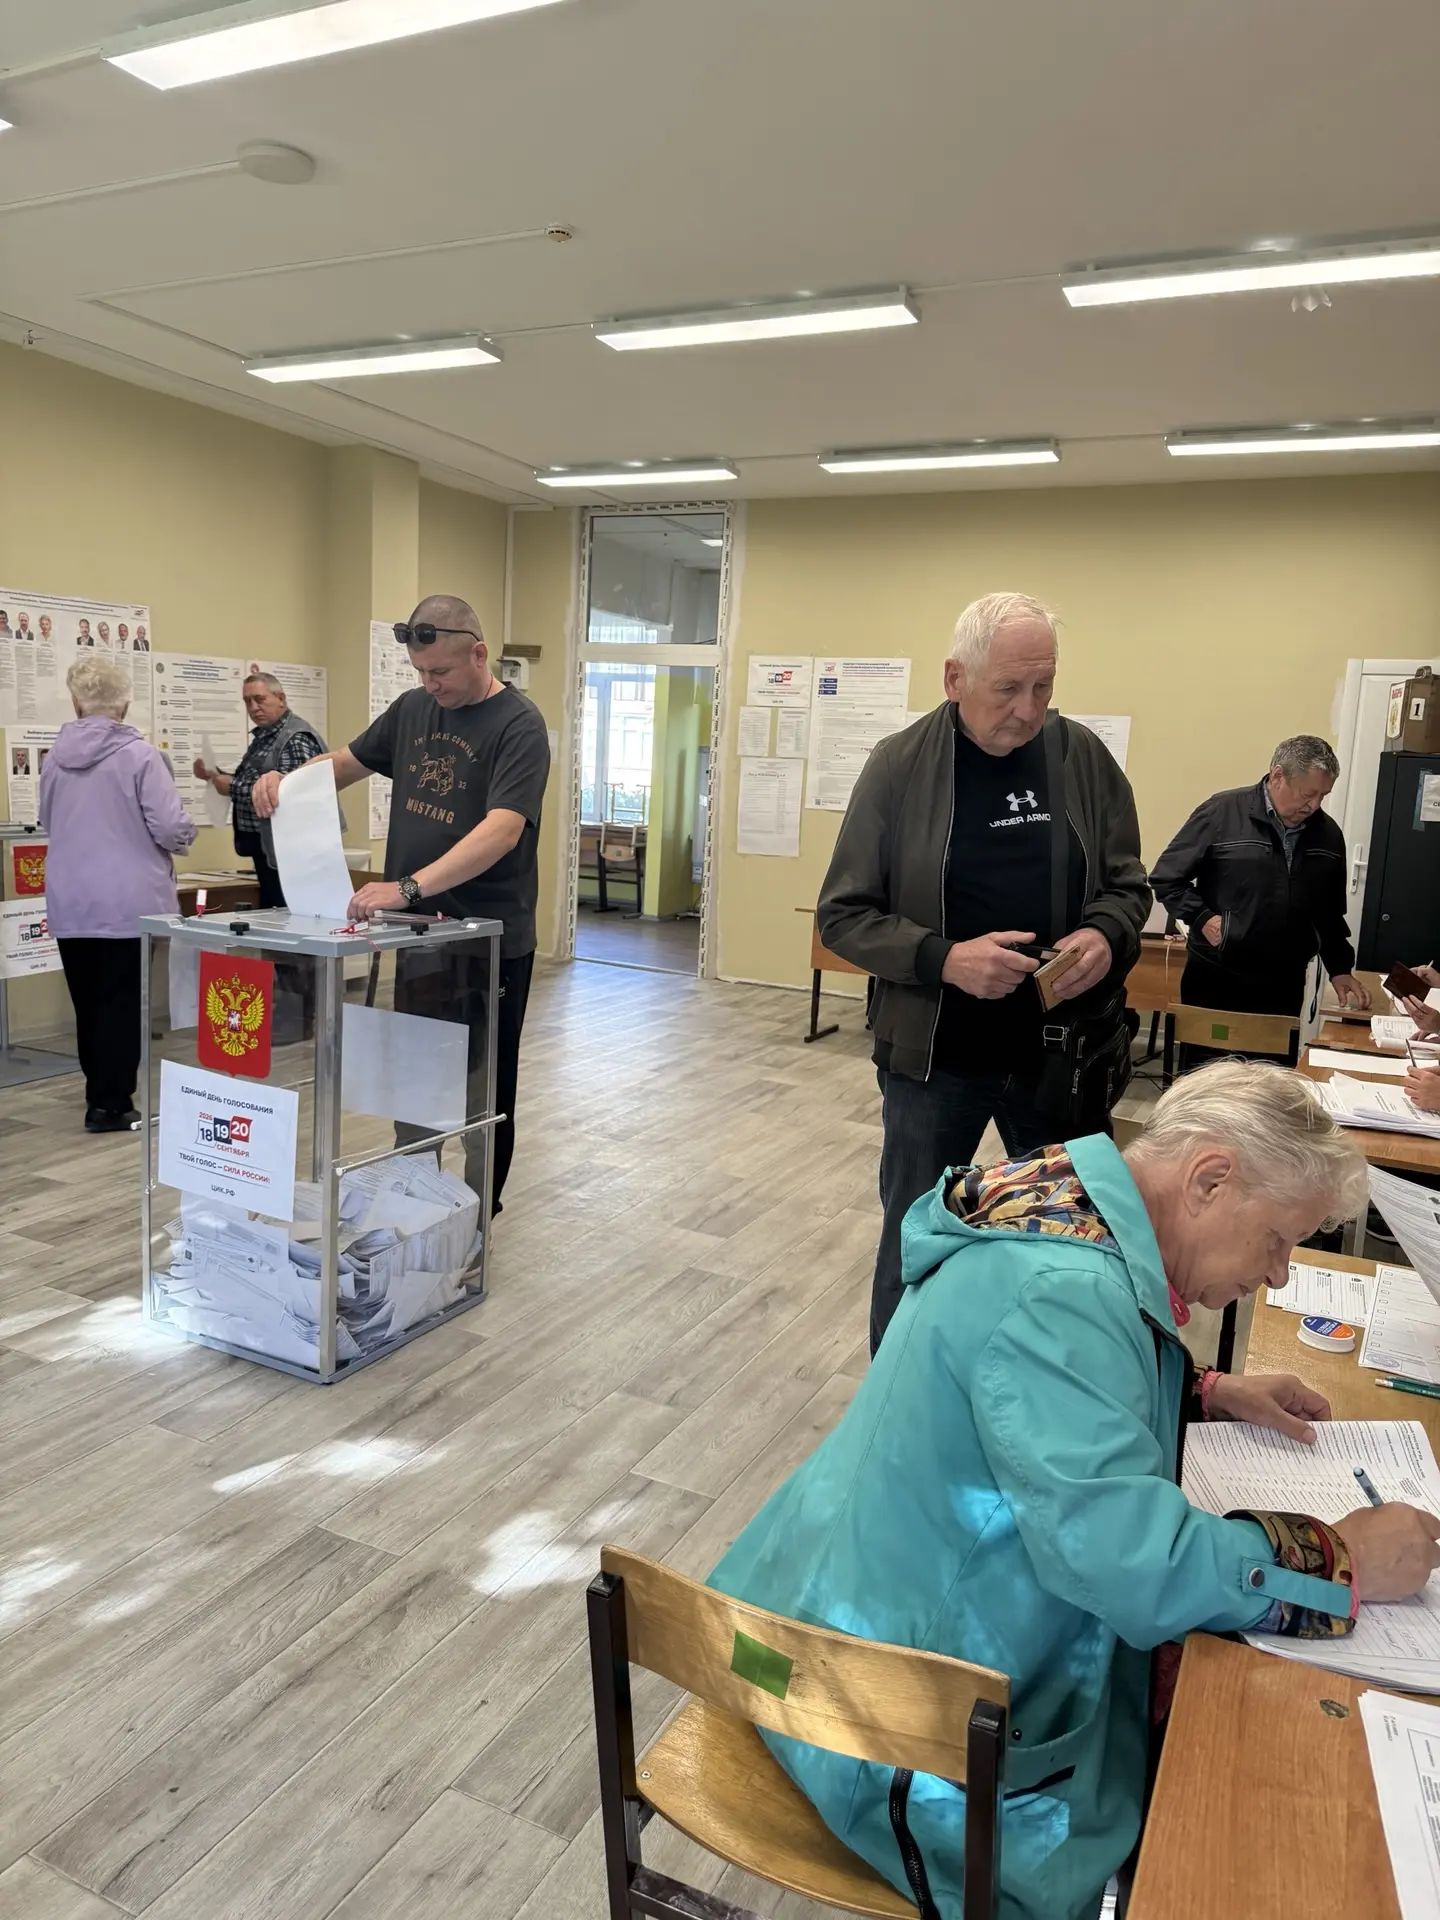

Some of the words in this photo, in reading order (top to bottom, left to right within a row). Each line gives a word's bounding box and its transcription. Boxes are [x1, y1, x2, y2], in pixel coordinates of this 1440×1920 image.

[405, 797, 455, 824] MUSTANG
[989, 816, 1025, 828] UNDER
[1026, 813, 1051, 822] ARMO
[20, 932, 30, 942] 18
[31, 927, 40, 936] 19
[41, 922, 48, 930] 2
[181, 1085, 207, 1099] ЕДИНЫЙ
[207, 1093, 222, 1104] ДЕНЬ
[223, 1097, 274, 1114] ГОЛОСОВАНИЯ
[200, 1128, 213, 1142] 18
[215, 1124, 229, 1139] 19
[231, 1120, 249, 1137] 20
[179, 1152, 195, 1164] ТВОЙ
[195, 1157, 217, 1169] ГОЛОС
[223, 1165, 241, 1176] СИЛА
